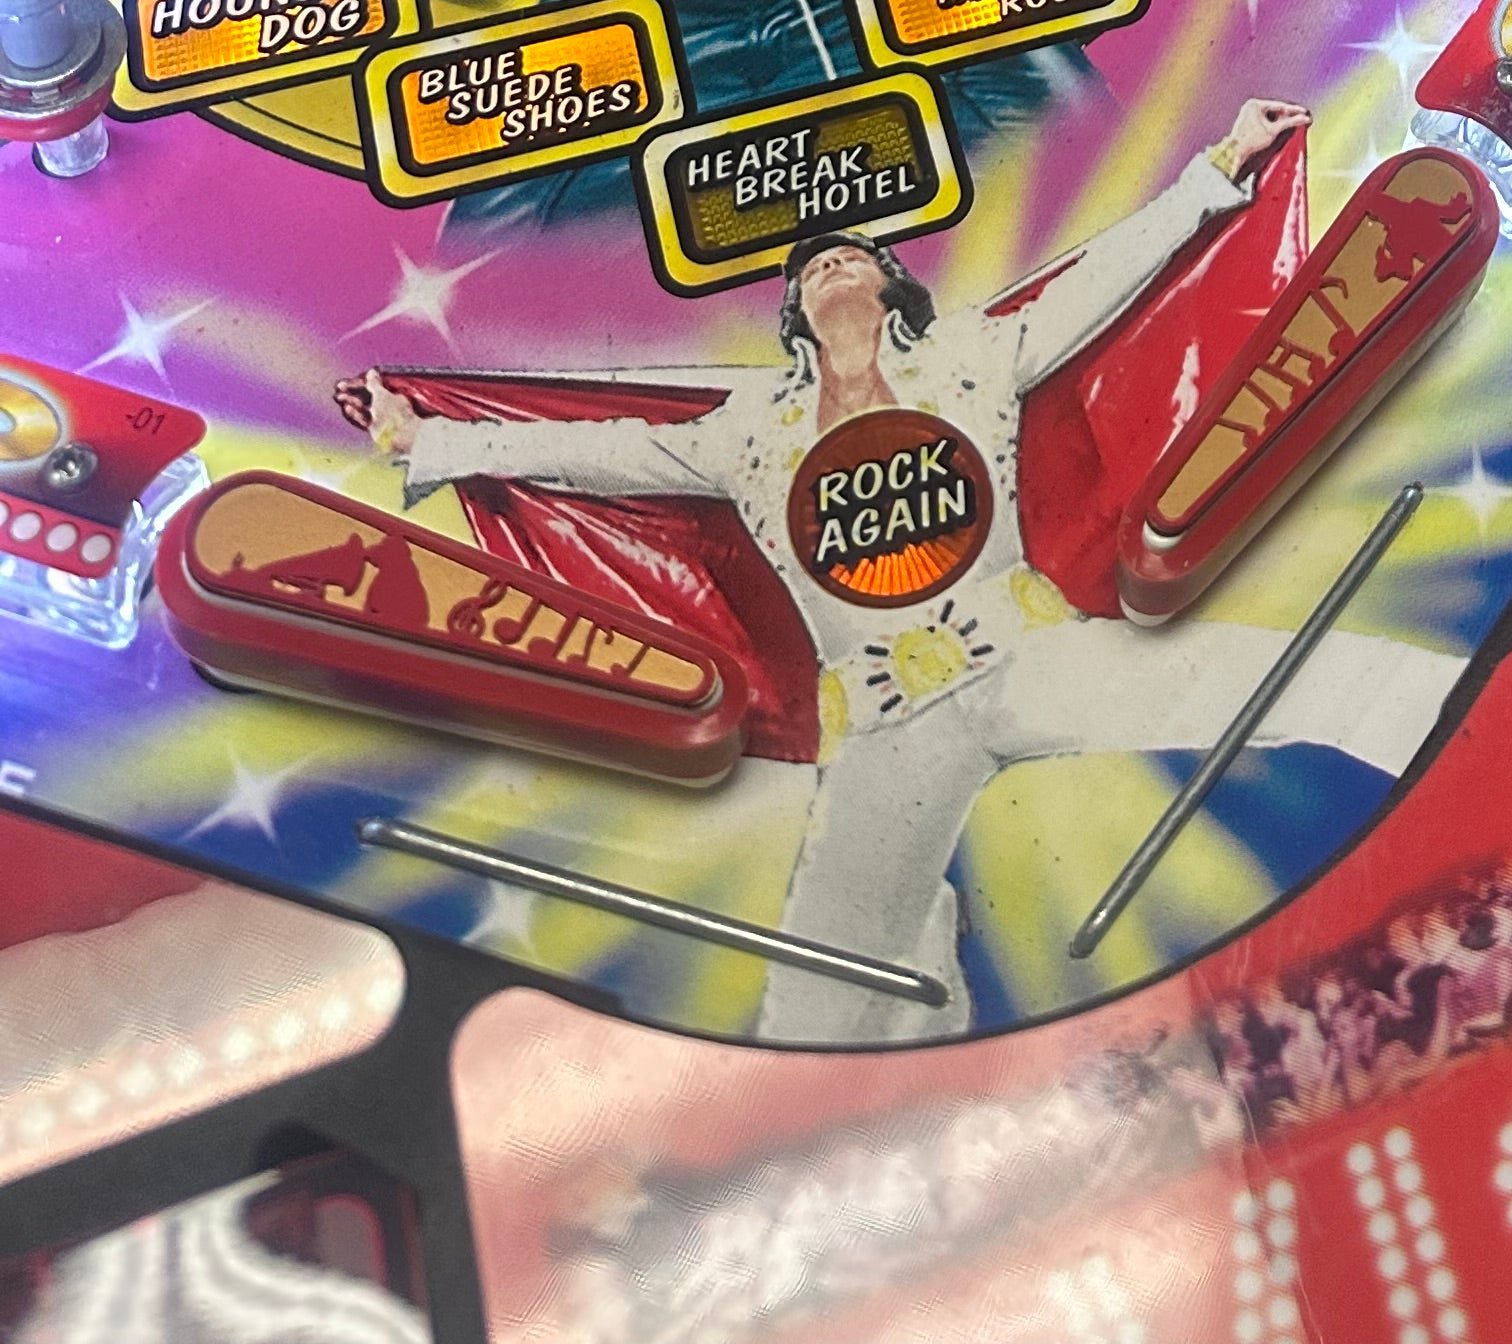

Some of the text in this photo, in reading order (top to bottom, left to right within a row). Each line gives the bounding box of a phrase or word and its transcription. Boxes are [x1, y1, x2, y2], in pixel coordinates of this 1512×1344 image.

[419, 52, 516, 99] BLUE
[447, 67, 574, 121] SUEDE
[501, 84, 633, 140] SHOES
[687, 129, 812, 188] HEART
[735, 146, 863, 208] BREAK
[800, 166, 915, 221] HOTEL
[125, 407, 166, 436] -01
[818, 439, 950, 510] ROCK
[815, 480, 969, 563] AGAIN
